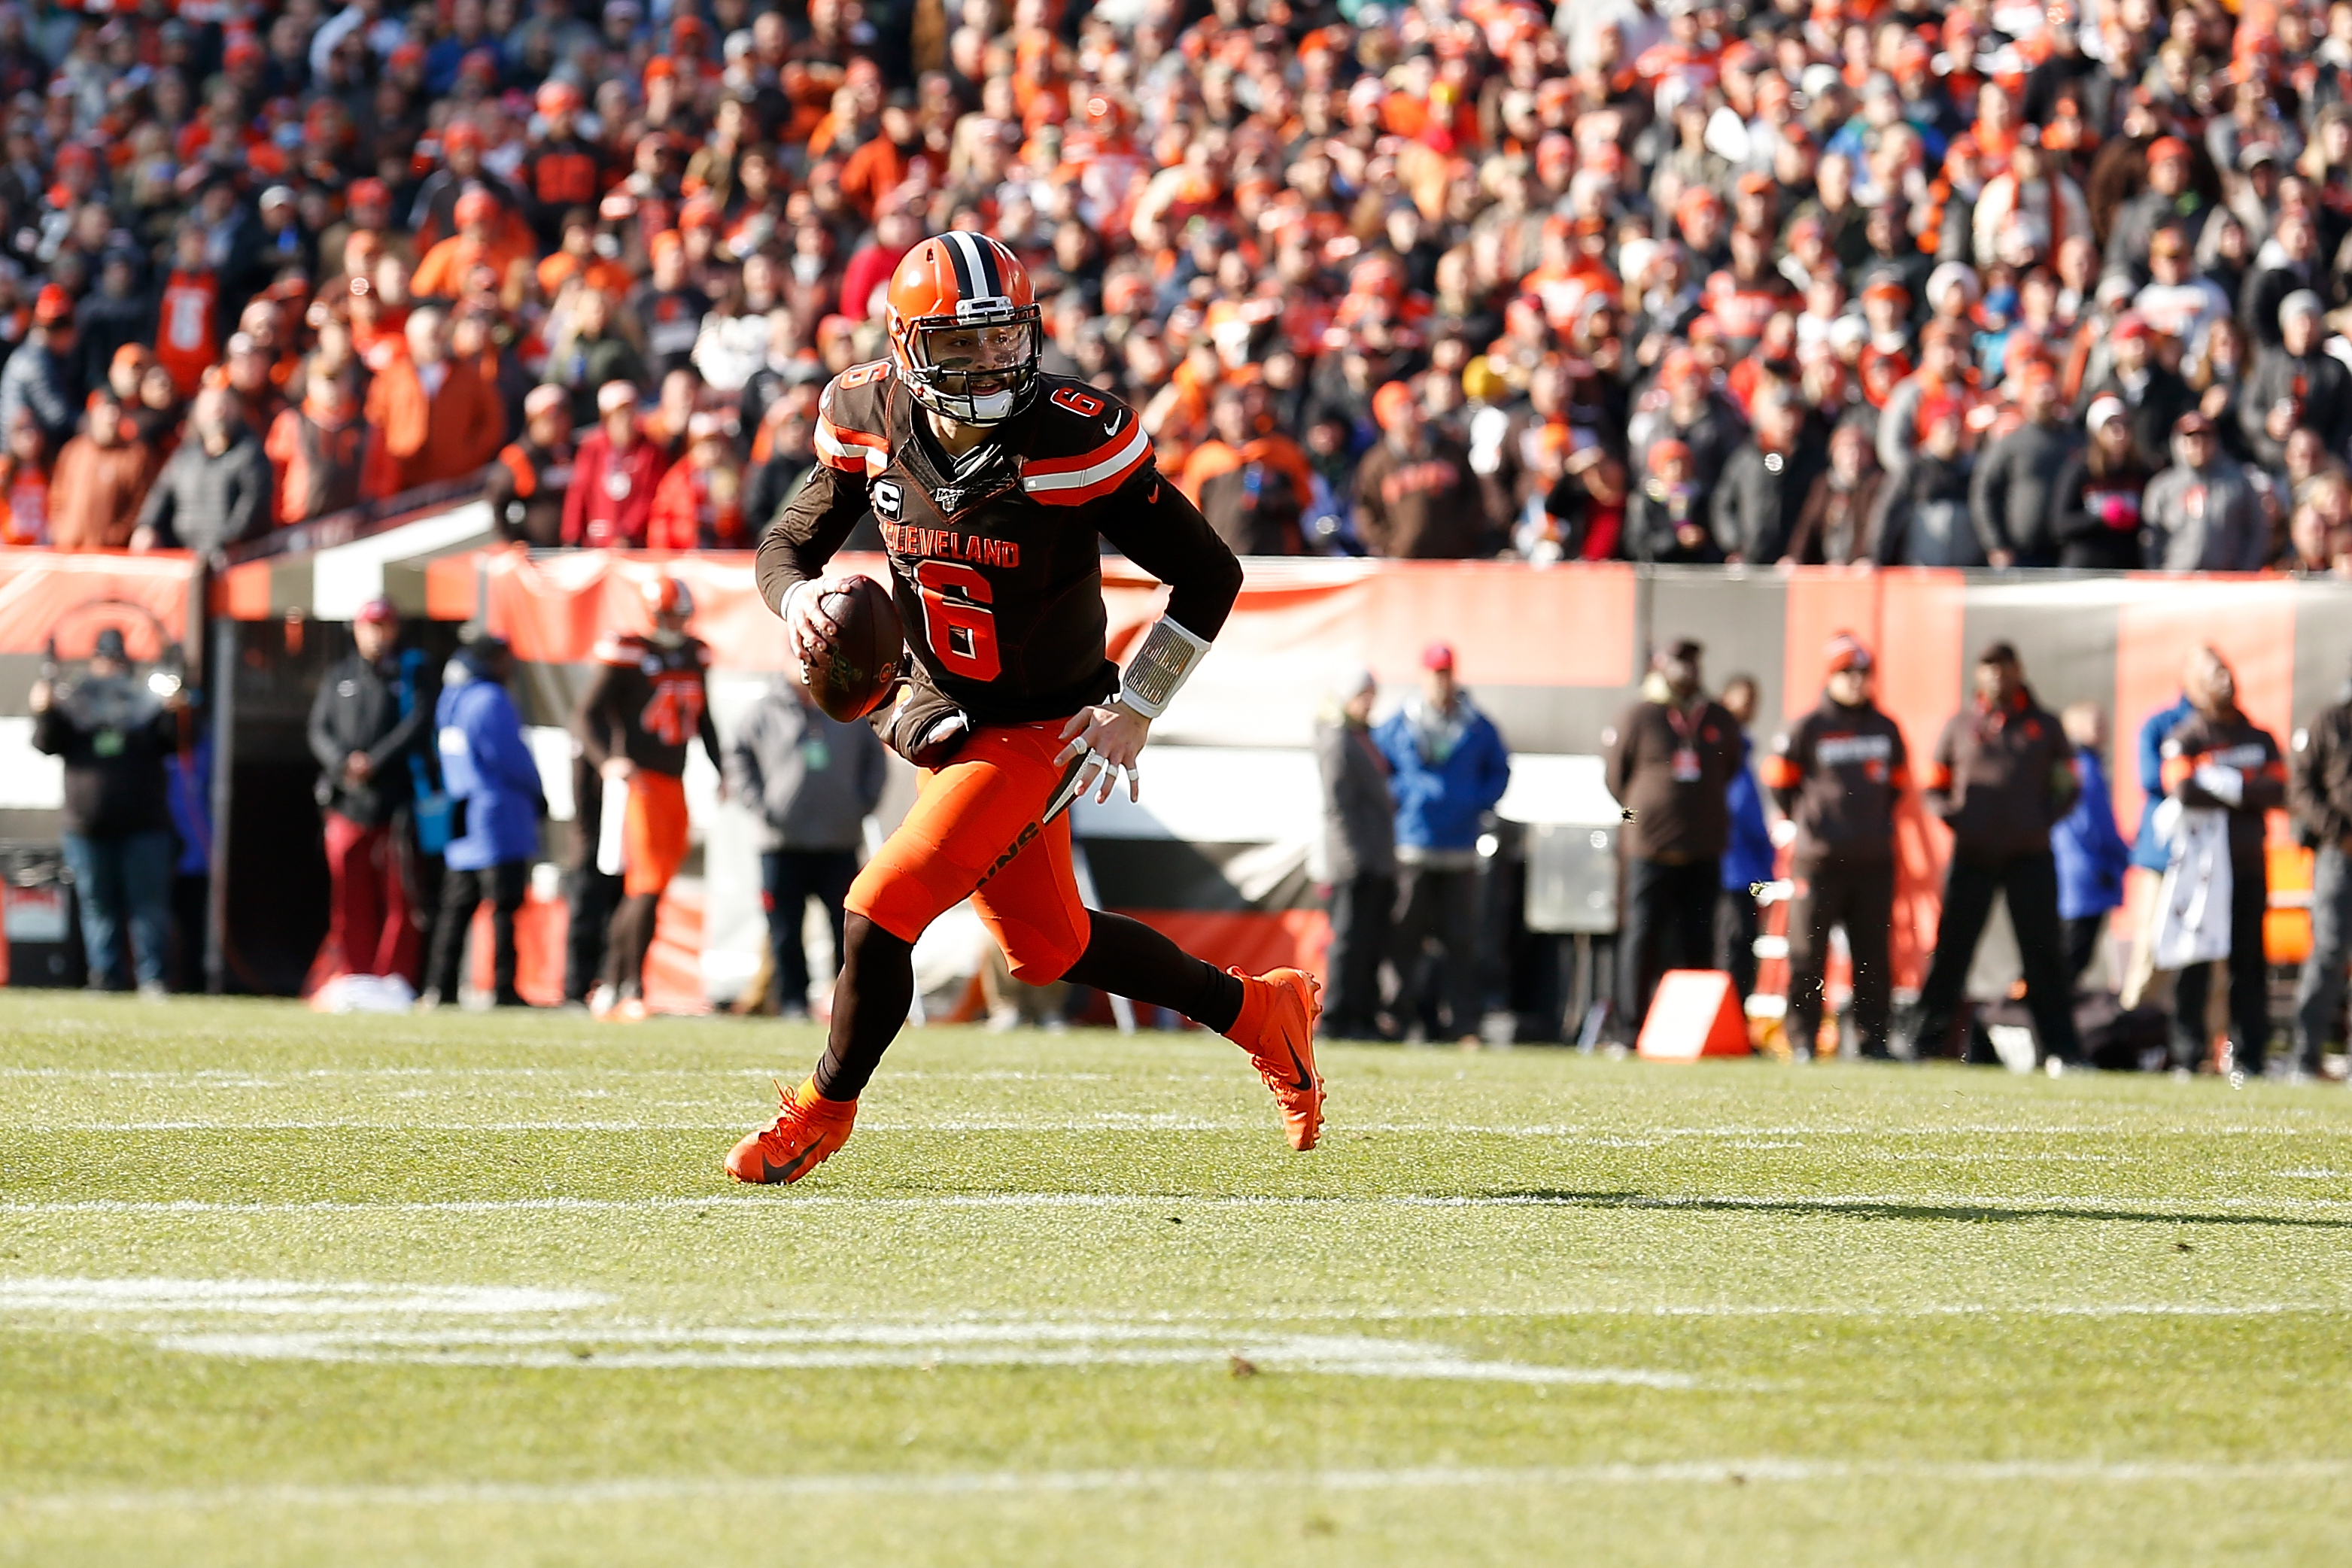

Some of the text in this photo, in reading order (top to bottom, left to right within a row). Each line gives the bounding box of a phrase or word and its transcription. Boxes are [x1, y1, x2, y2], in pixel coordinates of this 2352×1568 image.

[839, 362, 892, 390] 6
[1050, 387, 1106, 417] 6
[875, 482, 900, 512] C
[883, 521, 1020, 568] CLEVELAND
[913, 559, 1001, 682] 6
